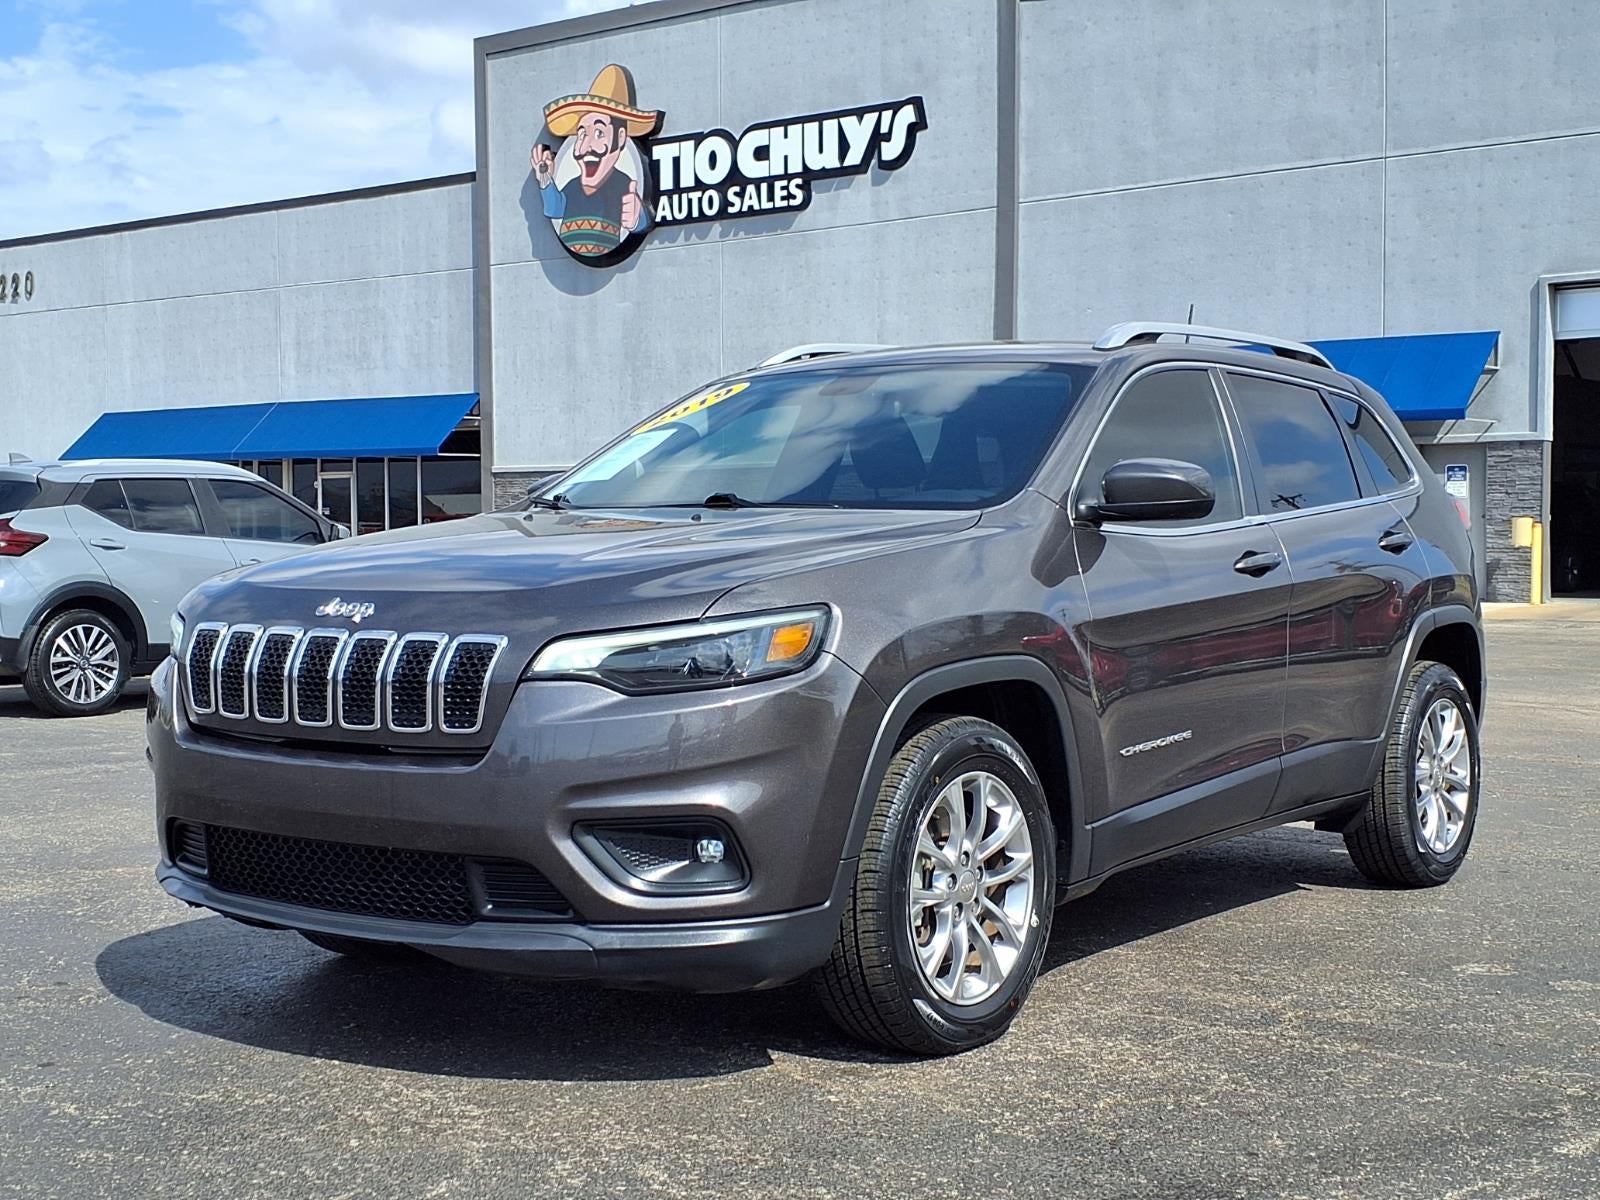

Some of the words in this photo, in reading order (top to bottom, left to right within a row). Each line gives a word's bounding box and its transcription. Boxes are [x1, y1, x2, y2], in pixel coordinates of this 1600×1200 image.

[652, 136, 732, 190] TIO
[736, 104, 916, 179] CHUY'S
[655, 189, 720, 222] AUTO
[727, 178, 803, 213] SALES
[315, 597, 375, 623] Jeep
[1119, 730, 1193, 756] CHEROKEE
